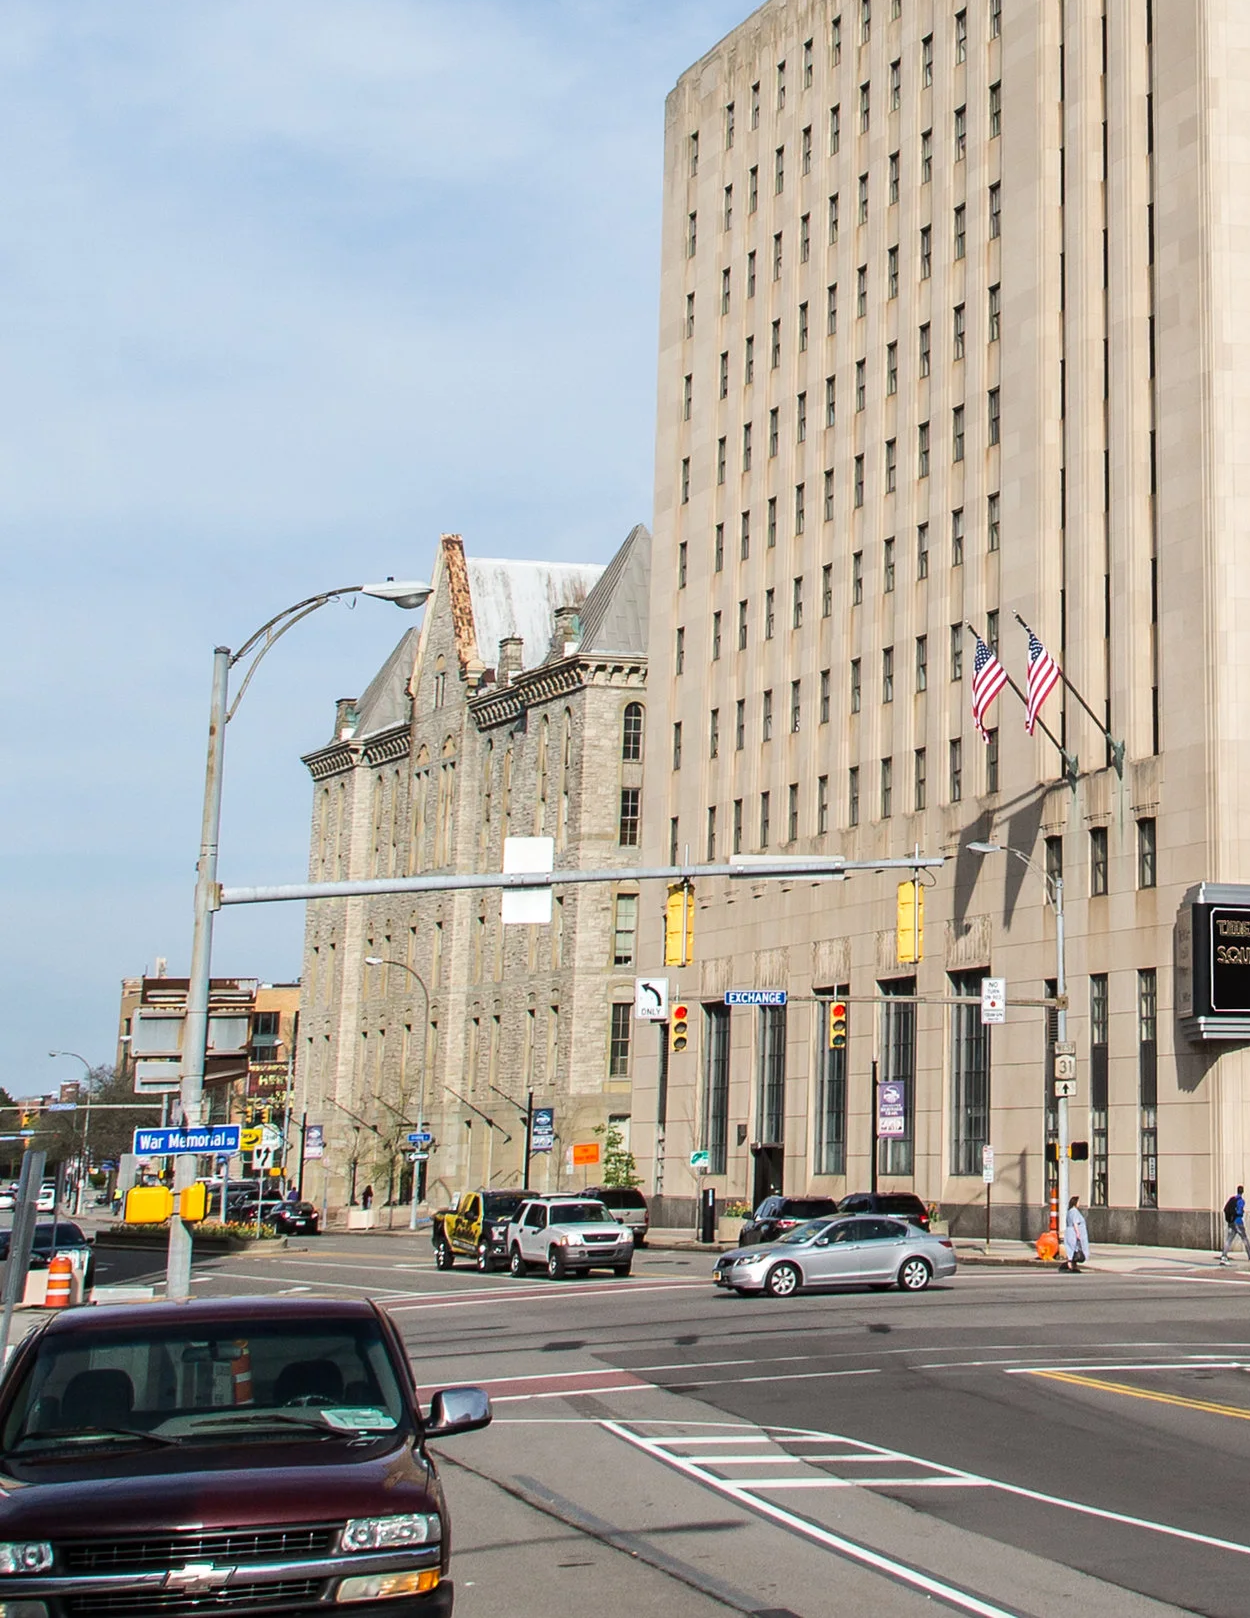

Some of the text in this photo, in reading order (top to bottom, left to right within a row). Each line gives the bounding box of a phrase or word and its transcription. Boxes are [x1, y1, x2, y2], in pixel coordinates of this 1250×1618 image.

[728, 992, 781, 1003] EXCHANGE
[640, 1008, 662, 1016] ONLY
[1059, 1060, 1073, 1074] 31
[140, 1134, 164, 1150] War
[167, 1131, 225, 1149] Memorial
